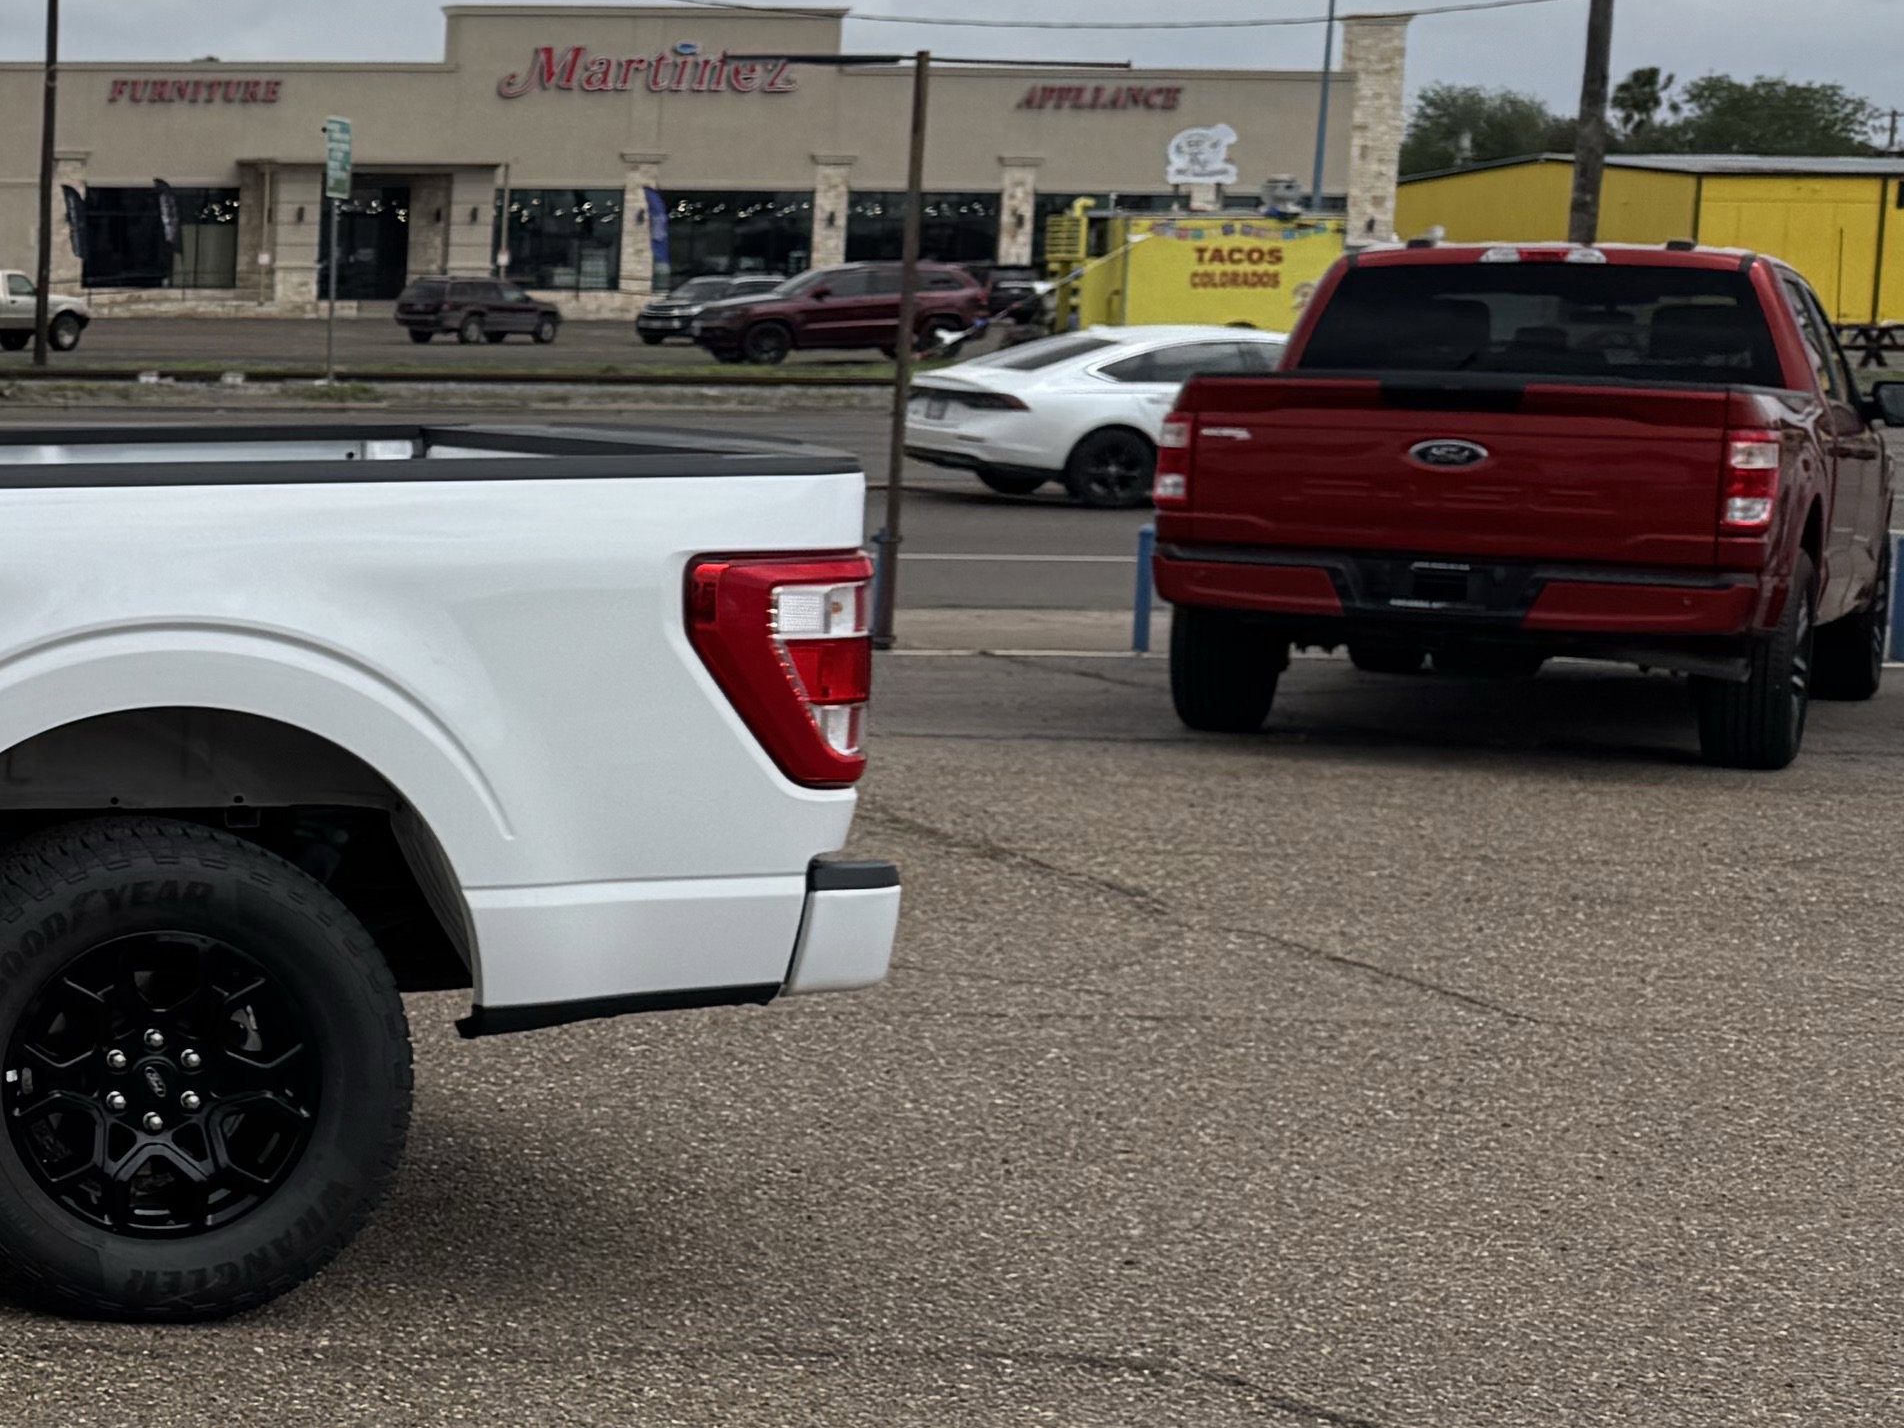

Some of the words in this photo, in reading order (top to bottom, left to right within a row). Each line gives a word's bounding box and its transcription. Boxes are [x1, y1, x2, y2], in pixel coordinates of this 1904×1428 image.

[496, 43, 796, 99] Martinez
[107, 79, 283, 104] FURNITURE
[1016, 85, 1185, 110] APPLIANCE
[1195, 246, 1284, 265] TACOS
[127, 1182, 352, 1296] WRANGLER
